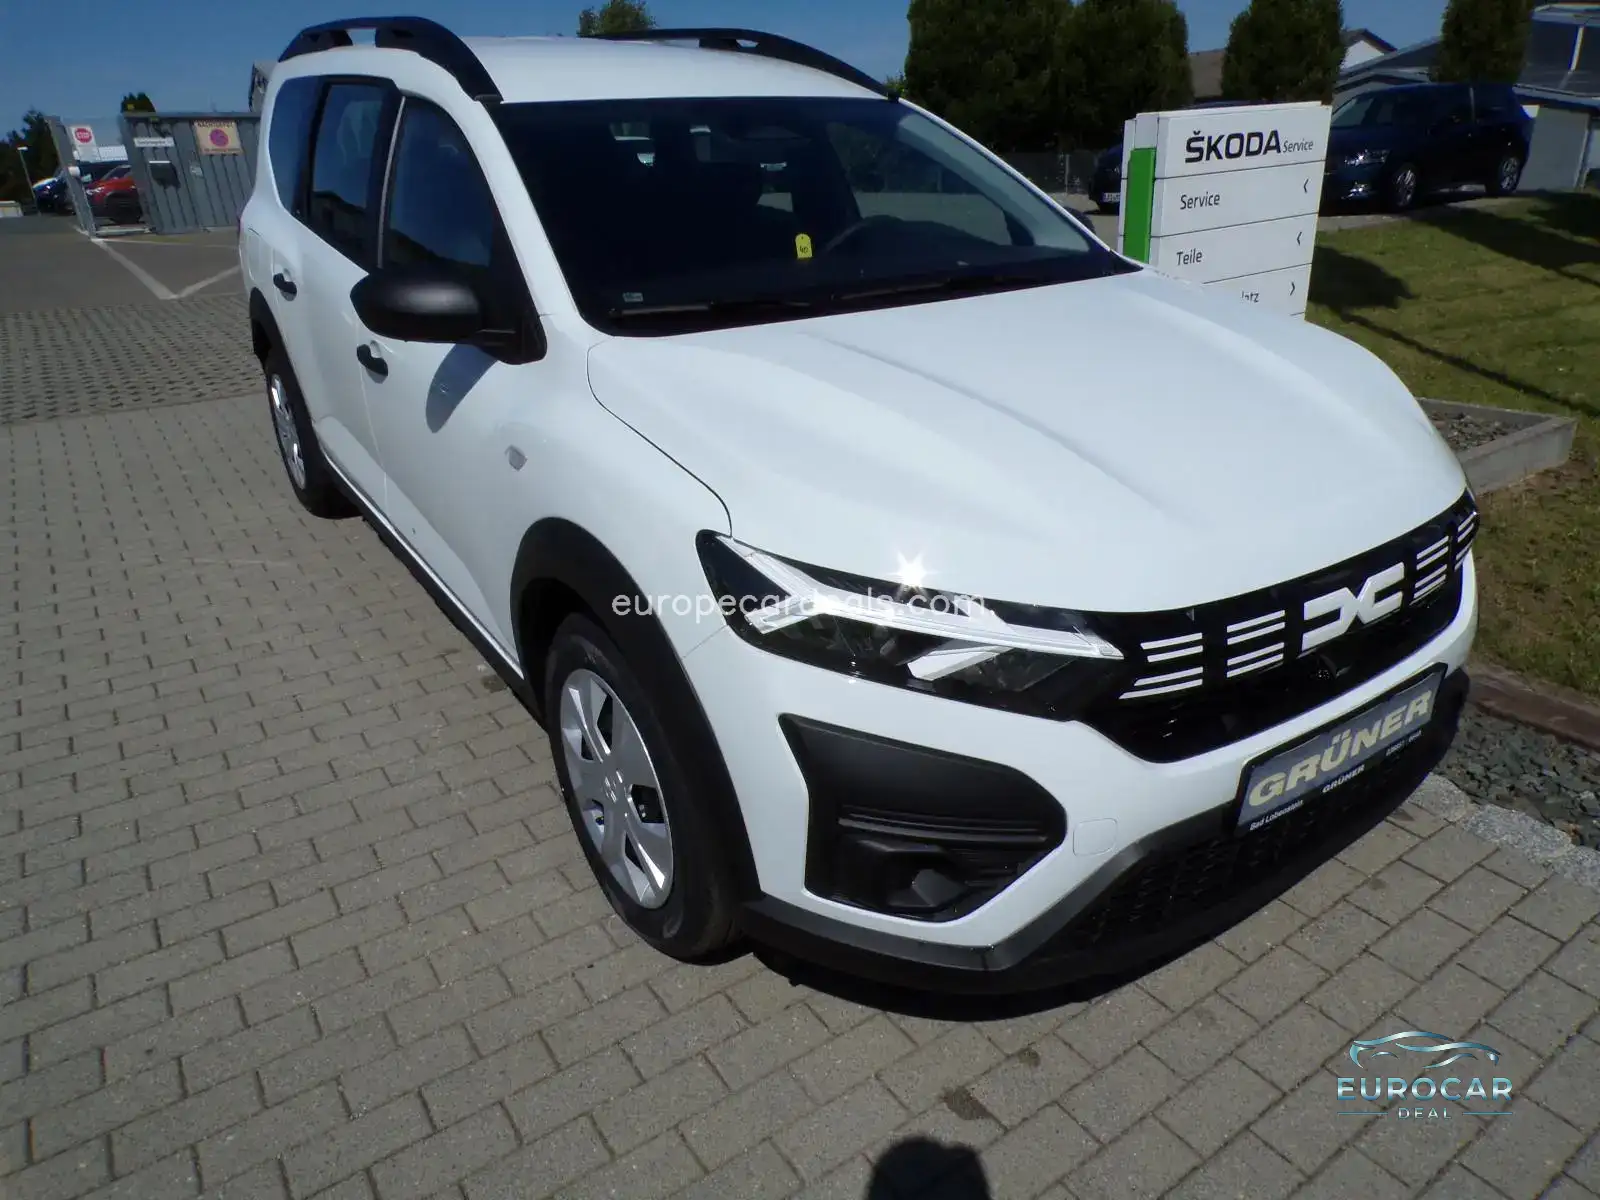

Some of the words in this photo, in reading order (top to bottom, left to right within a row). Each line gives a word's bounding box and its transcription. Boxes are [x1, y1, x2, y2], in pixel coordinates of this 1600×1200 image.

[1185, 130, 1281, 163] ŠKODA
[1282, 139, 1314, 153] Service
[1180, 192, 1221, 210] Service
[1176, 249, 1203, 266] Teile
[1249, 690, 1432, 806] GRÜNER
[1322, 764, 1365, 793] GRÜNER
